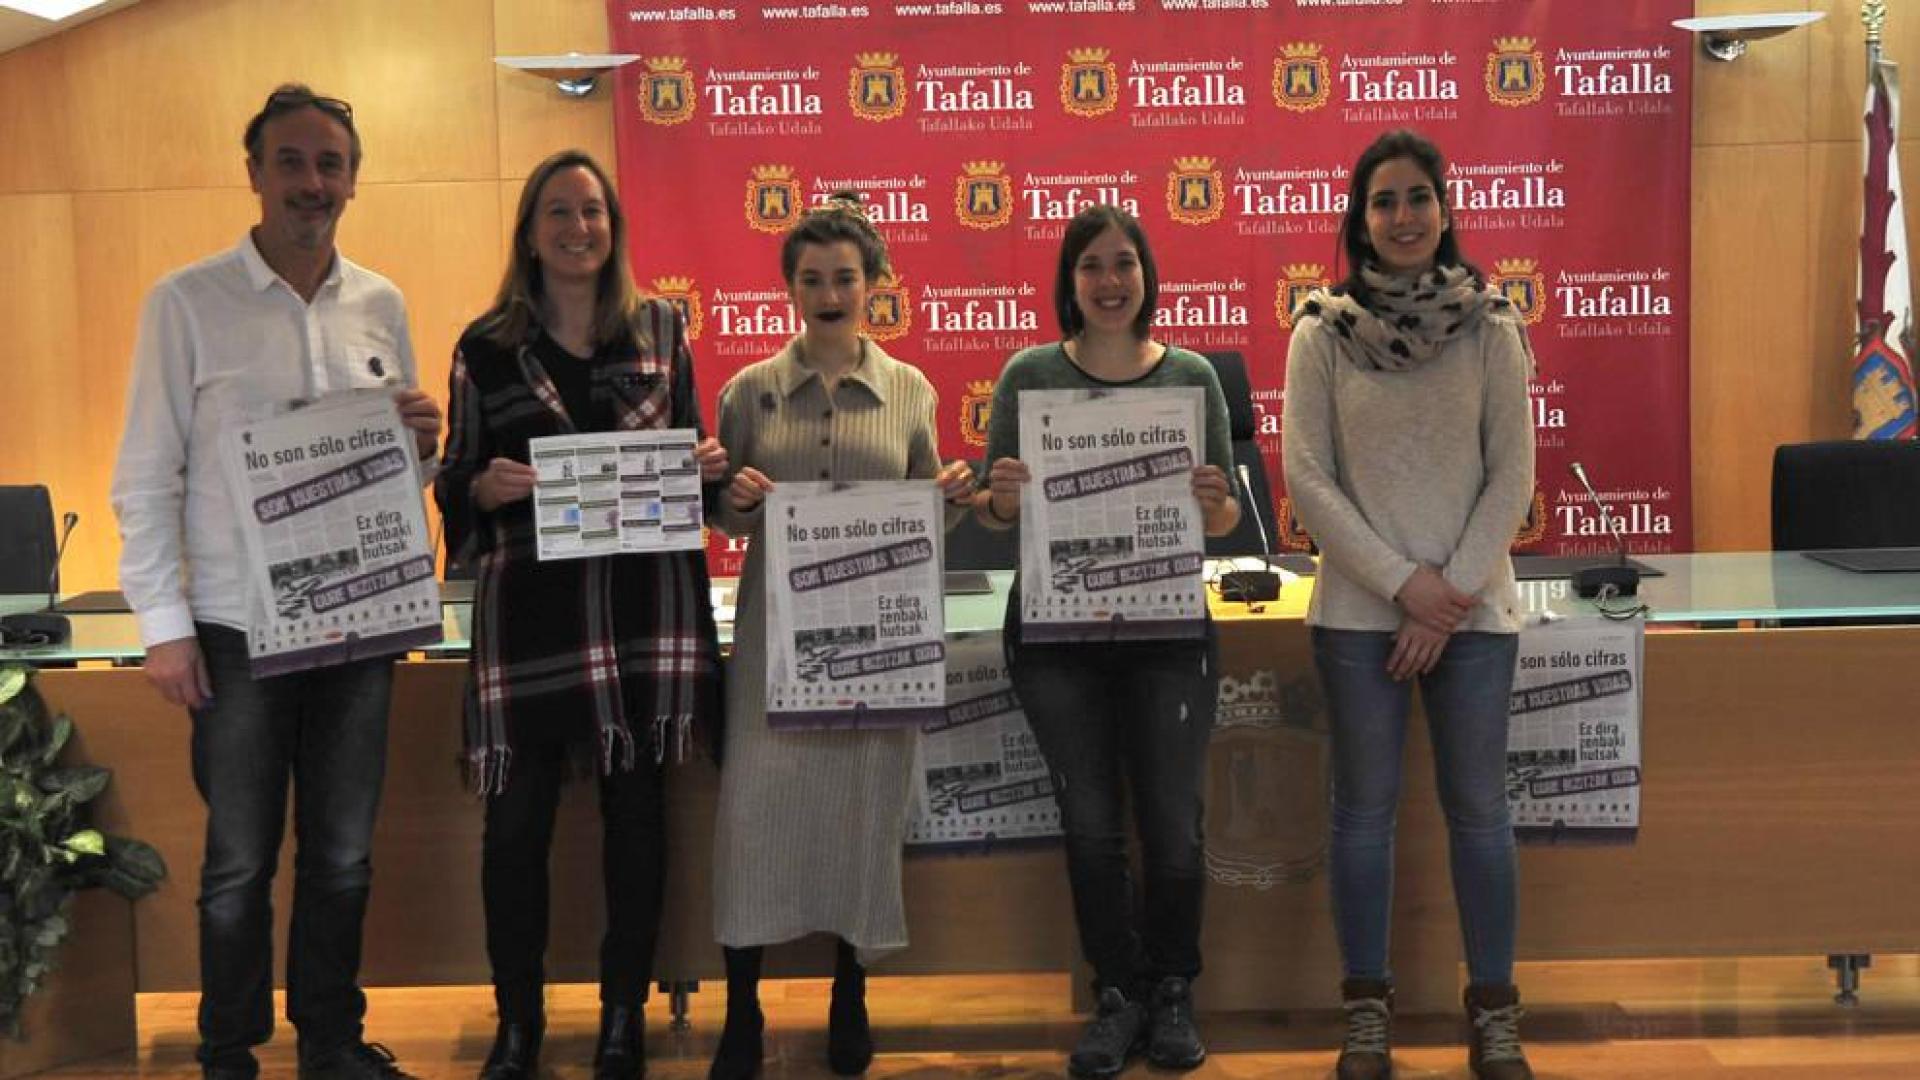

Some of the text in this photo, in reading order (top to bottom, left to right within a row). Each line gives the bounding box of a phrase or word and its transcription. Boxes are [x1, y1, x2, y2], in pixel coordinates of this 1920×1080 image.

[629, 7, 736, 22] www.tafalla.es
[762, 4, 869, 19] www.tafalla.es
[896, 1, 1002, 17] www.tafalla.es
[1028, 0, 1136, 13] www.tafalla.es
[1341, 51, 1457, 70] Ayuntamiento de
[1555, 46, 1671, 64] Ayuntamiento de
[706, 65, 820, 83] Ayuntamiento de
[917, 62, 1032, 79] Ayuntamiento de
[1129, 57, 1243, 75] Ayuntamiento de
[1339, 69, 1459, 102] Tafalla
[1554, 63, 1673, 97] Tafalla
[705, 83, 823, 116] Tafalla
[916, 79, 1034, 112] Tafalla
[1128, 75, 1245, 108] Tafalla
[1342, 107, 1458, 123] Tafallako Udala
[1556, 100, 1672, 117] Tafallako Udala
[708, 120, 822, 136] Tafallako Udala
[919, 117, 1033, 132] Tafallako Udala
[1131, 112, 1245, 128] Tafallako Udala
[1235, 165, 1350, 183] Ayuntamiento de
[1446, 159, 1565, 177] Ayuntamiento de
[813, 174, 926, 192] Ayuntamiento de
[1023, 170, 1138, 188] Ayuntamiento de
[1233, 183, 1349, 215] Tafalla
[1446, 176, 1566, 210] Tafalla
[811, 191, 930, 223] alla
[1237, 219, 1341, 235] Tafallako Udal
[1521, 213, 1565, 228] Udala
[1024, 226, 1066, 241] Tafall
[1556, 267, 1671, 285] Ayuntamiento de
[922, 281, 1037, 300] Ayuntamiento de
[1159, 278, 1247, 293] ntamiento de
[713, 288, 789, 304] Ayuntamie
[1555, 285, 1673, 317] Tafalla
[711, 303, 807, 336] Tafal
[920, 299, 1039, 332] Tafalla
[1153, 295, 1249, 326] afalla
[1205, 331, 1249, 345] Udala
[1557, 321, 1671, 338] Tafallako Udala
[923, 338, 990, 352] Tafallako
[1547, 380, 1564, 394] de
[1042, 426, 1187, 450] No son sólo cifras
[245, 427, 396, 471] No son sólo cifras
[1652, 486, 1671, 500] de
[356, 511, 403, 531] Ez dira
[1136, 505, 1180, 521] Ez dira
[1555, 504, 1673, 536] Tafalla
[359, 521, 412, 544] zenbaki
[787, 516, 926, 542] No son sólo cifras
[1137, 518, 1187, 535] zenbaki
[1138, 533, 1182, 548] hutsak
[361, 541, 408, 560] hutsak
[878, 594, 921, 610] Ez dira
[879, 606, 928, 624] zenbaki
[880, 622, 922, 638] hutsak
[1520, 649, 1627, 670] son sólo cifras
[946, 672, 963, 686] on
[1579, 721, 1619, 736] Ez dira
[1580, 734, 1626, 748] zenbaki
[1580, 746, 1620, 761] hutsak
